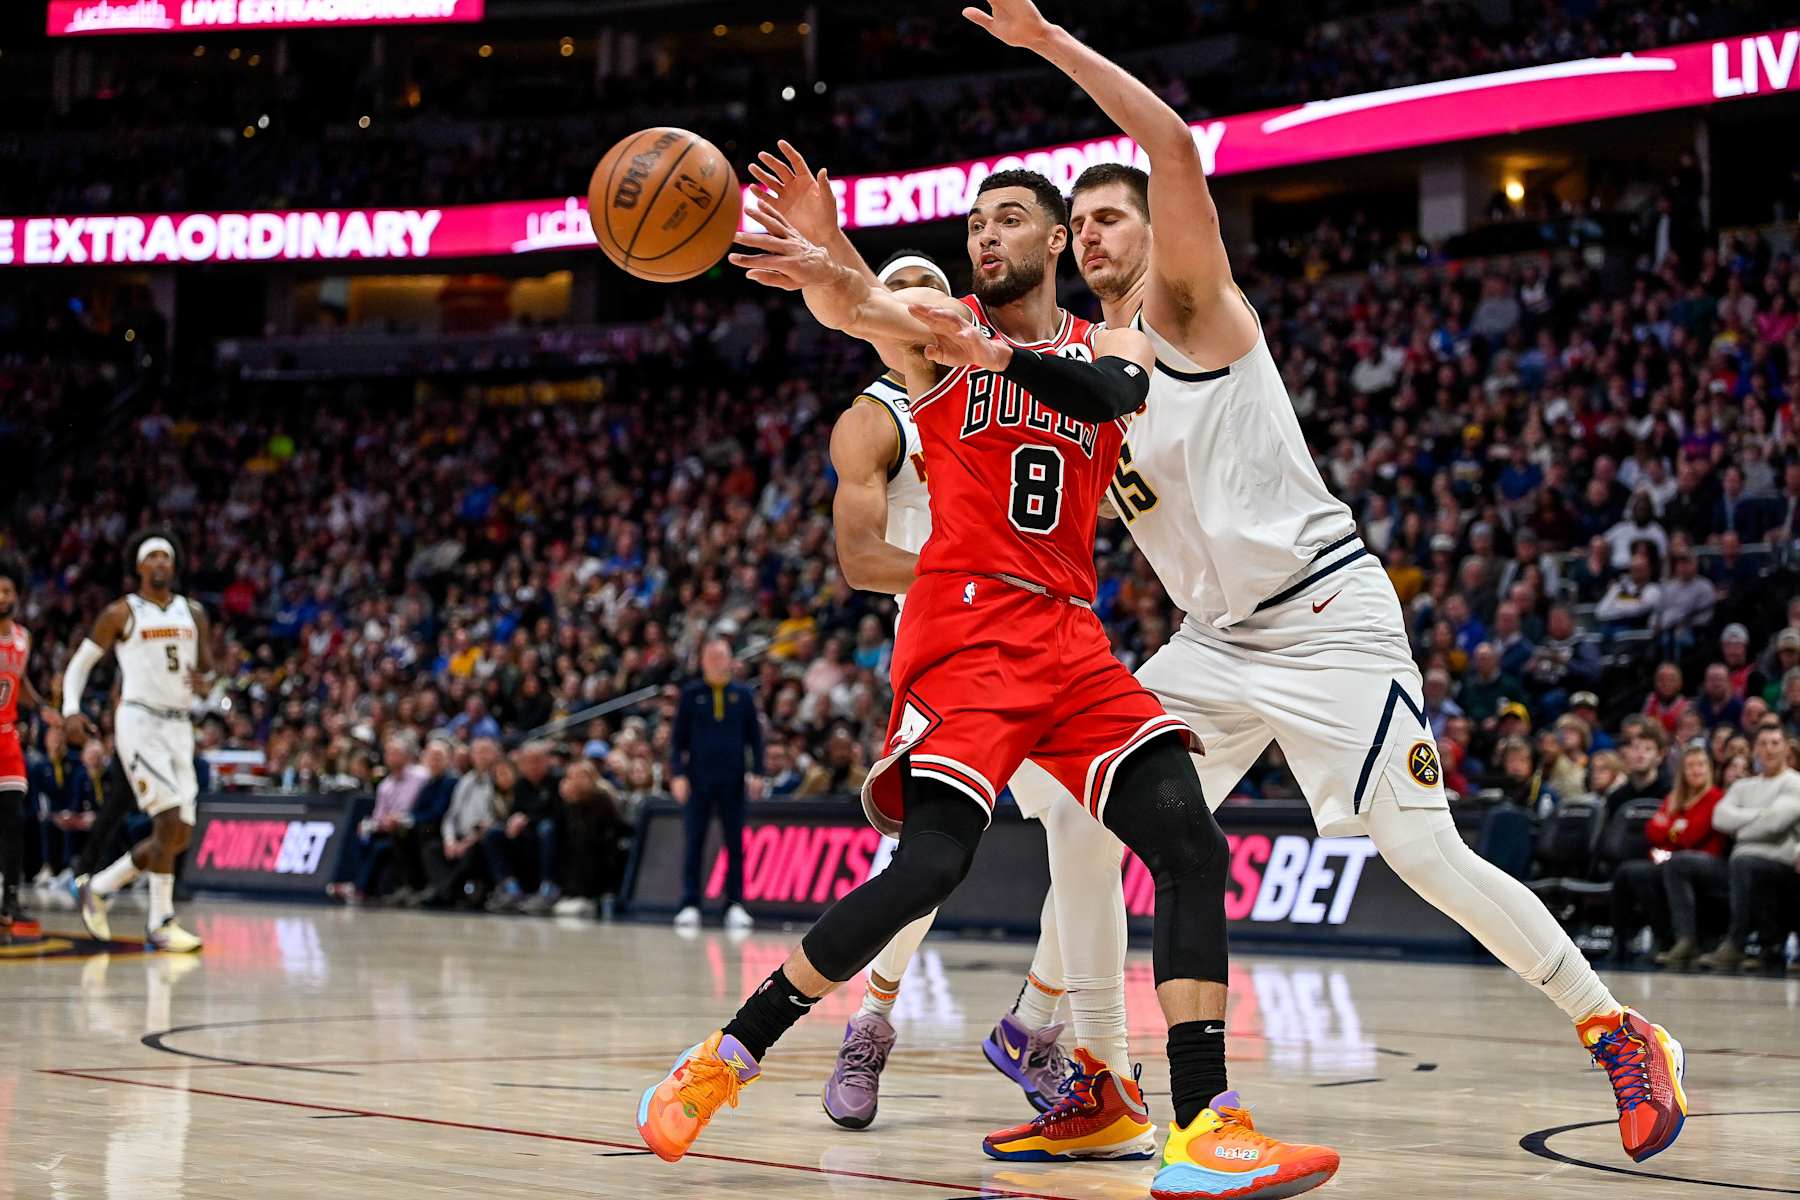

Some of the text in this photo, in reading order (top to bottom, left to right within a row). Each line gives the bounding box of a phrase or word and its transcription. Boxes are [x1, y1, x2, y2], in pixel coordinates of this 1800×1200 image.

[614, 131, 685, 210] Wilson
[24, 210, 441, 263] EXTRAORDINARY
[1007, 442, 1066, 535] 8
[165, 645, 180, 673] 5
[196, 820, 335, 875] POINTSBET
